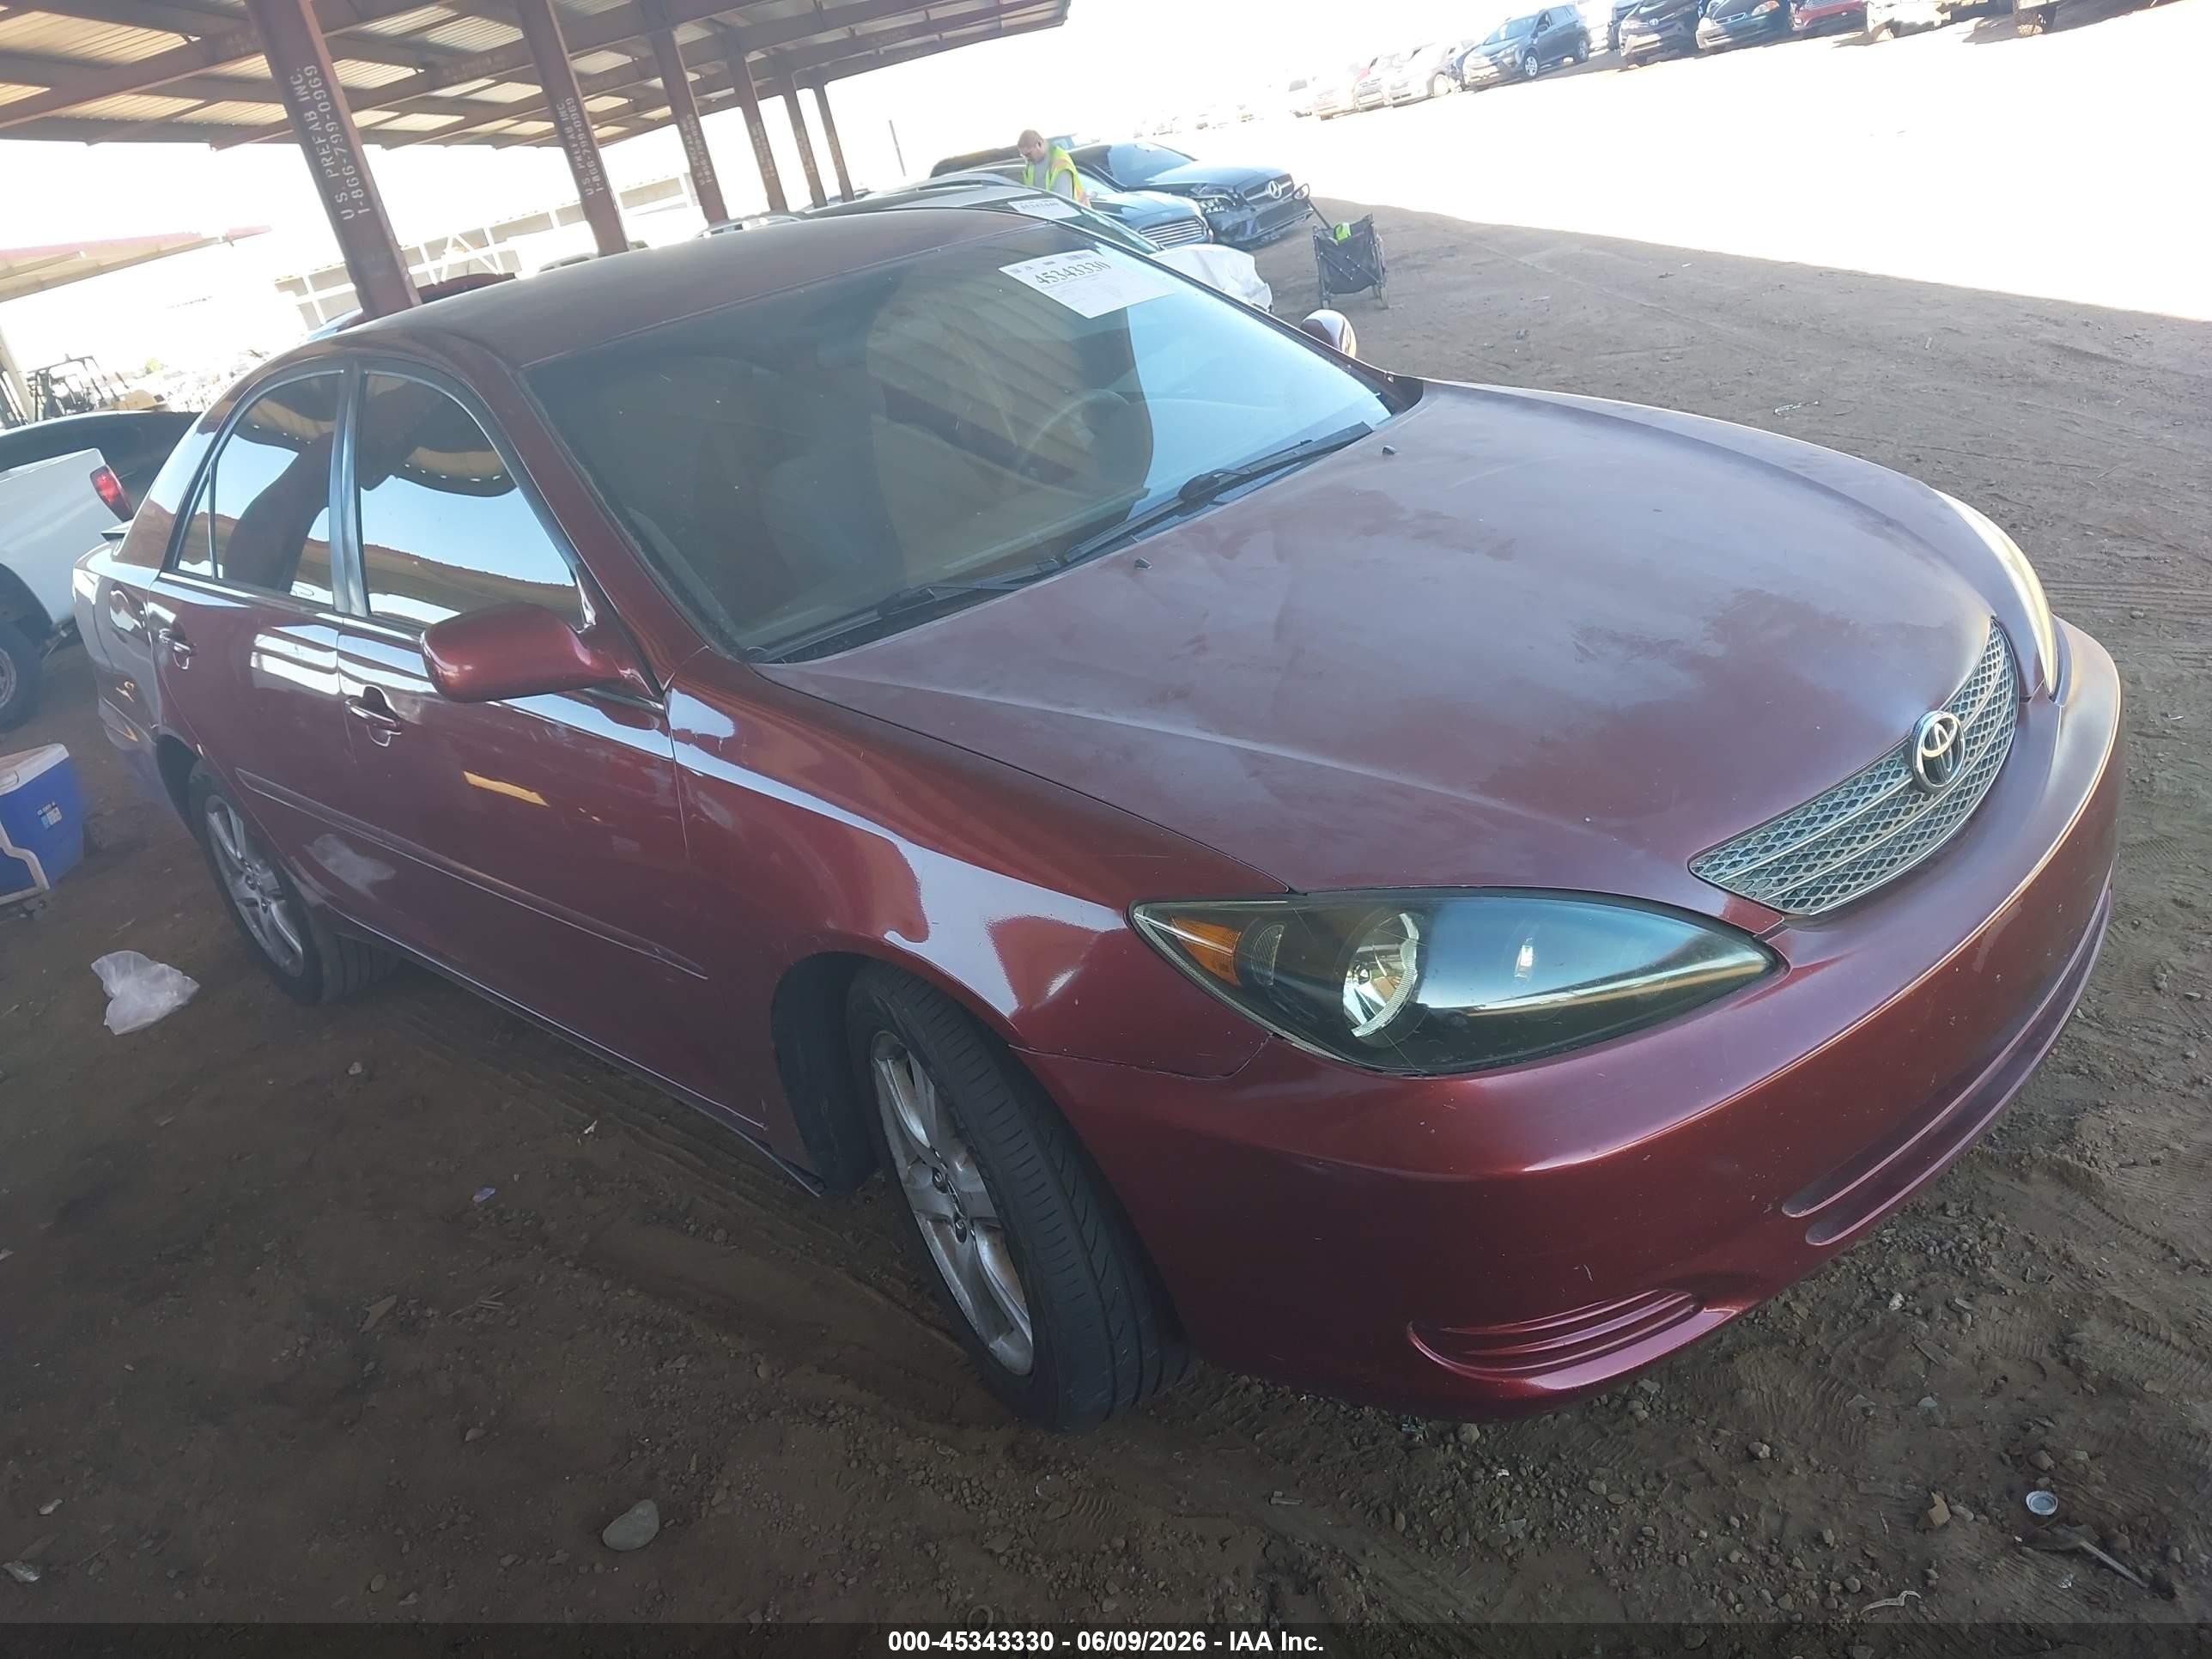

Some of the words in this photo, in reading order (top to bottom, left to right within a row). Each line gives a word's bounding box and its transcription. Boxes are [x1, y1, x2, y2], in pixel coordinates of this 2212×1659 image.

[303, 65, 370, 215] 1-866-799-0969
[303, 110, 340, 178] PREFAB
[1035, 260, 1111, 284] 45343330
